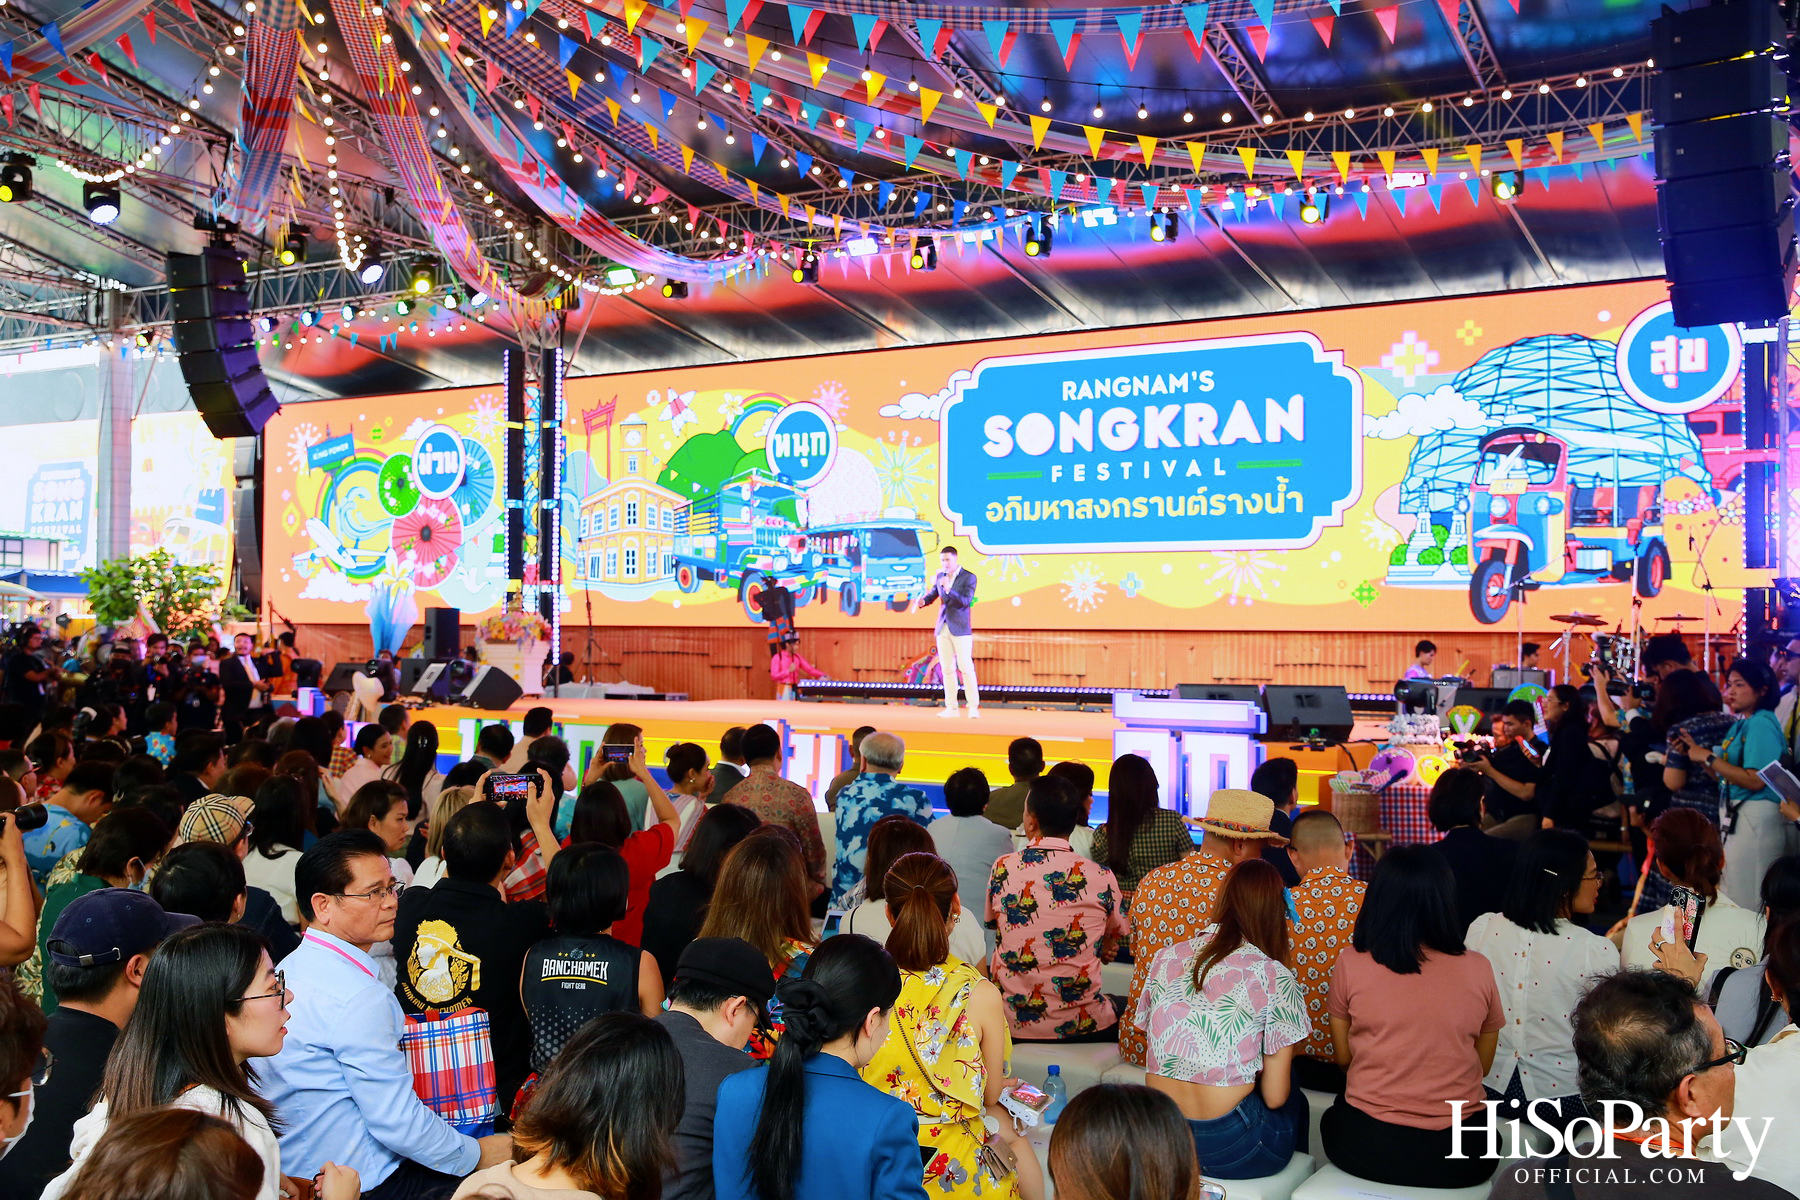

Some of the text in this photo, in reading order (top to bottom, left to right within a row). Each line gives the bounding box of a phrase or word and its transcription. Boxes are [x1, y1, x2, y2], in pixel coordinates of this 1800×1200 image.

[1651, 335, 1708, 388] สุข
[1062, 370, 1215, 401] RANGNAM'S
[982, 394, 1305, 458] SONGKRAN
[419, 443, 459, 475] ม่วน
[1051, 458, 1226, 483] FESTIVAL
[32, 479, 86, 503] SONG
[986, 475, 1304, 523] อภิมหาสงกรานต์รางน้ำ
[31, 499, 84, 524] KRAN
[542, 959, 609, 980] BANCHAMEK
